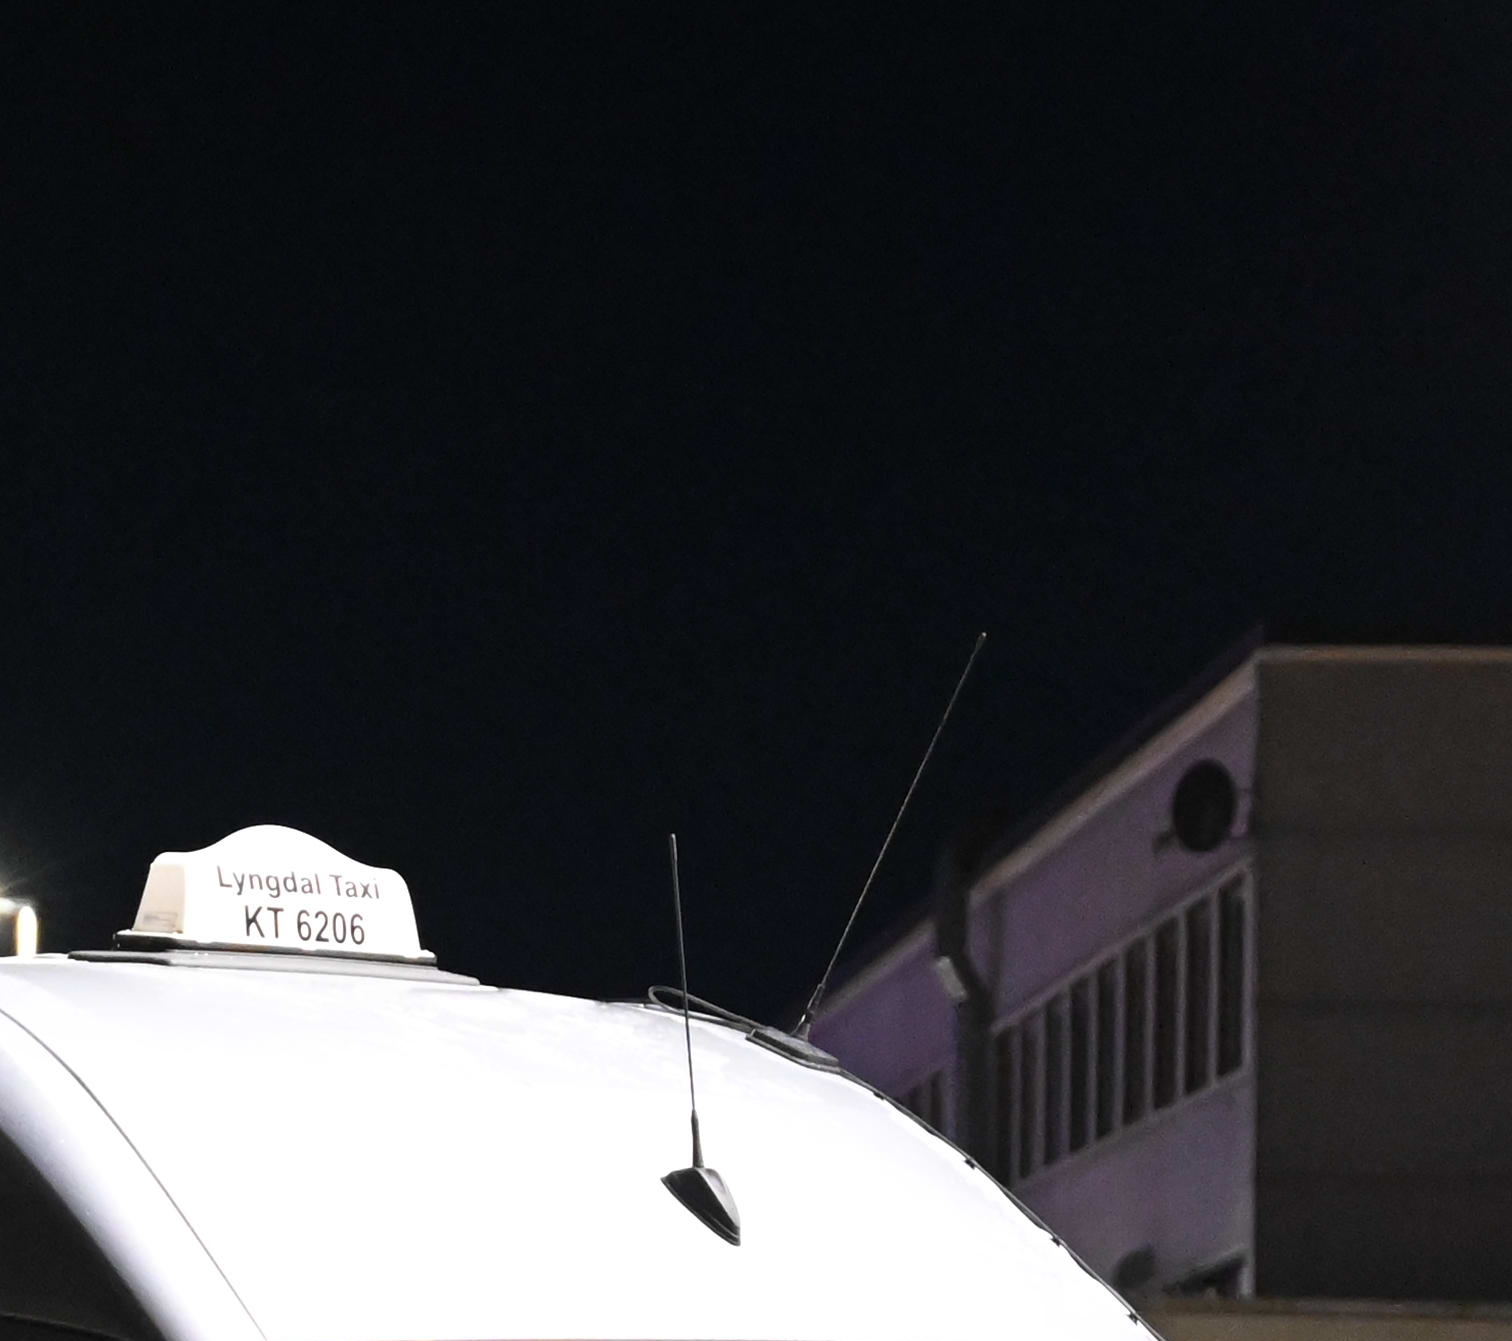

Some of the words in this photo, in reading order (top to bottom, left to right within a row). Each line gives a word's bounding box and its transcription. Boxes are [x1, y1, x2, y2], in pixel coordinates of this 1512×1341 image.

[216, 865, 321, 899] Lyngdal
[329, 874, 380, 900] Taxi
[244, 904, 285, 939] KT
[296, 909, 366, 945] 6206
